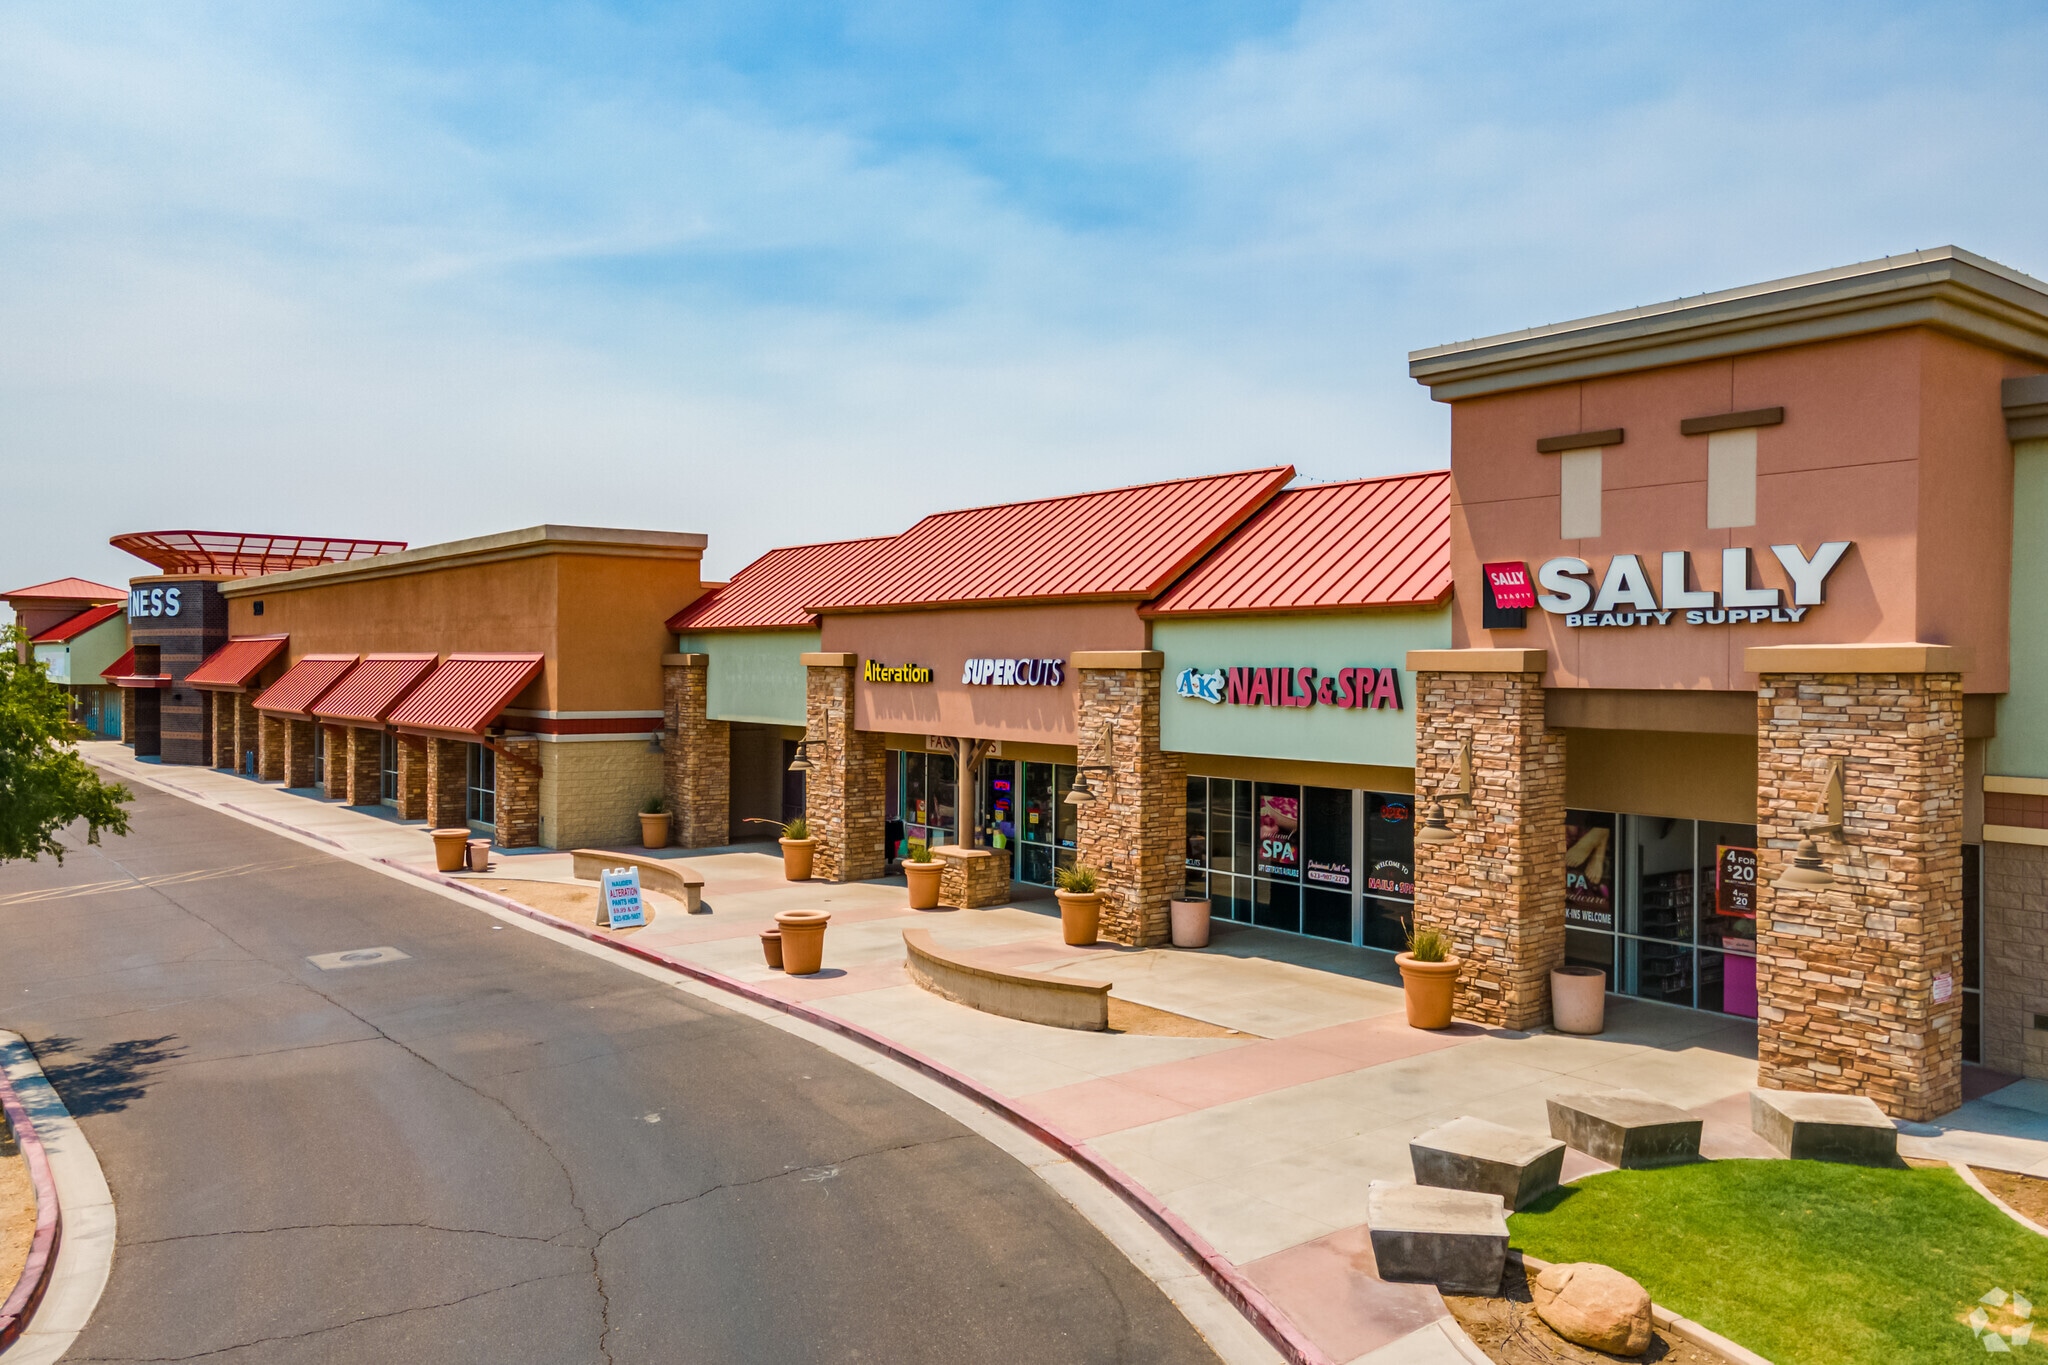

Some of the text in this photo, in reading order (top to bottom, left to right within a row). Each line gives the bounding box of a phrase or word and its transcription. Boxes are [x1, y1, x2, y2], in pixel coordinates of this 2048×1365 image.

[1491, 571, 1525, 587] SALLY
[1538, 541, 1852, 615] SALLY
[1497, 592, 1531, 600] BEAUTY
[1566, 607, 1807, 628] BEAUTY SUPPLY
[864, 659, 933, 683] Alteration
[962, 658, 1065, 687] SUPERCUTS
[1228, 667, 1316, 708] NAILS
[1318, 676, 1336, 705] &
[1337, 667, 1403, 710] SPA
[1262, 839, 1295, 861] SPA
[1726, 851, 1755, 865] 4 FOR
[1375, 860, 1409, 875] WELCOME TO
[1727, 865, 1754, 881] $20
[1368, 878, 1394, 892] NAILS
[1567, 873, 1588, 890] PA
[610, 888, 638, 898] ALTERATION
[1581, 910, 1612, 924] WELCOME
